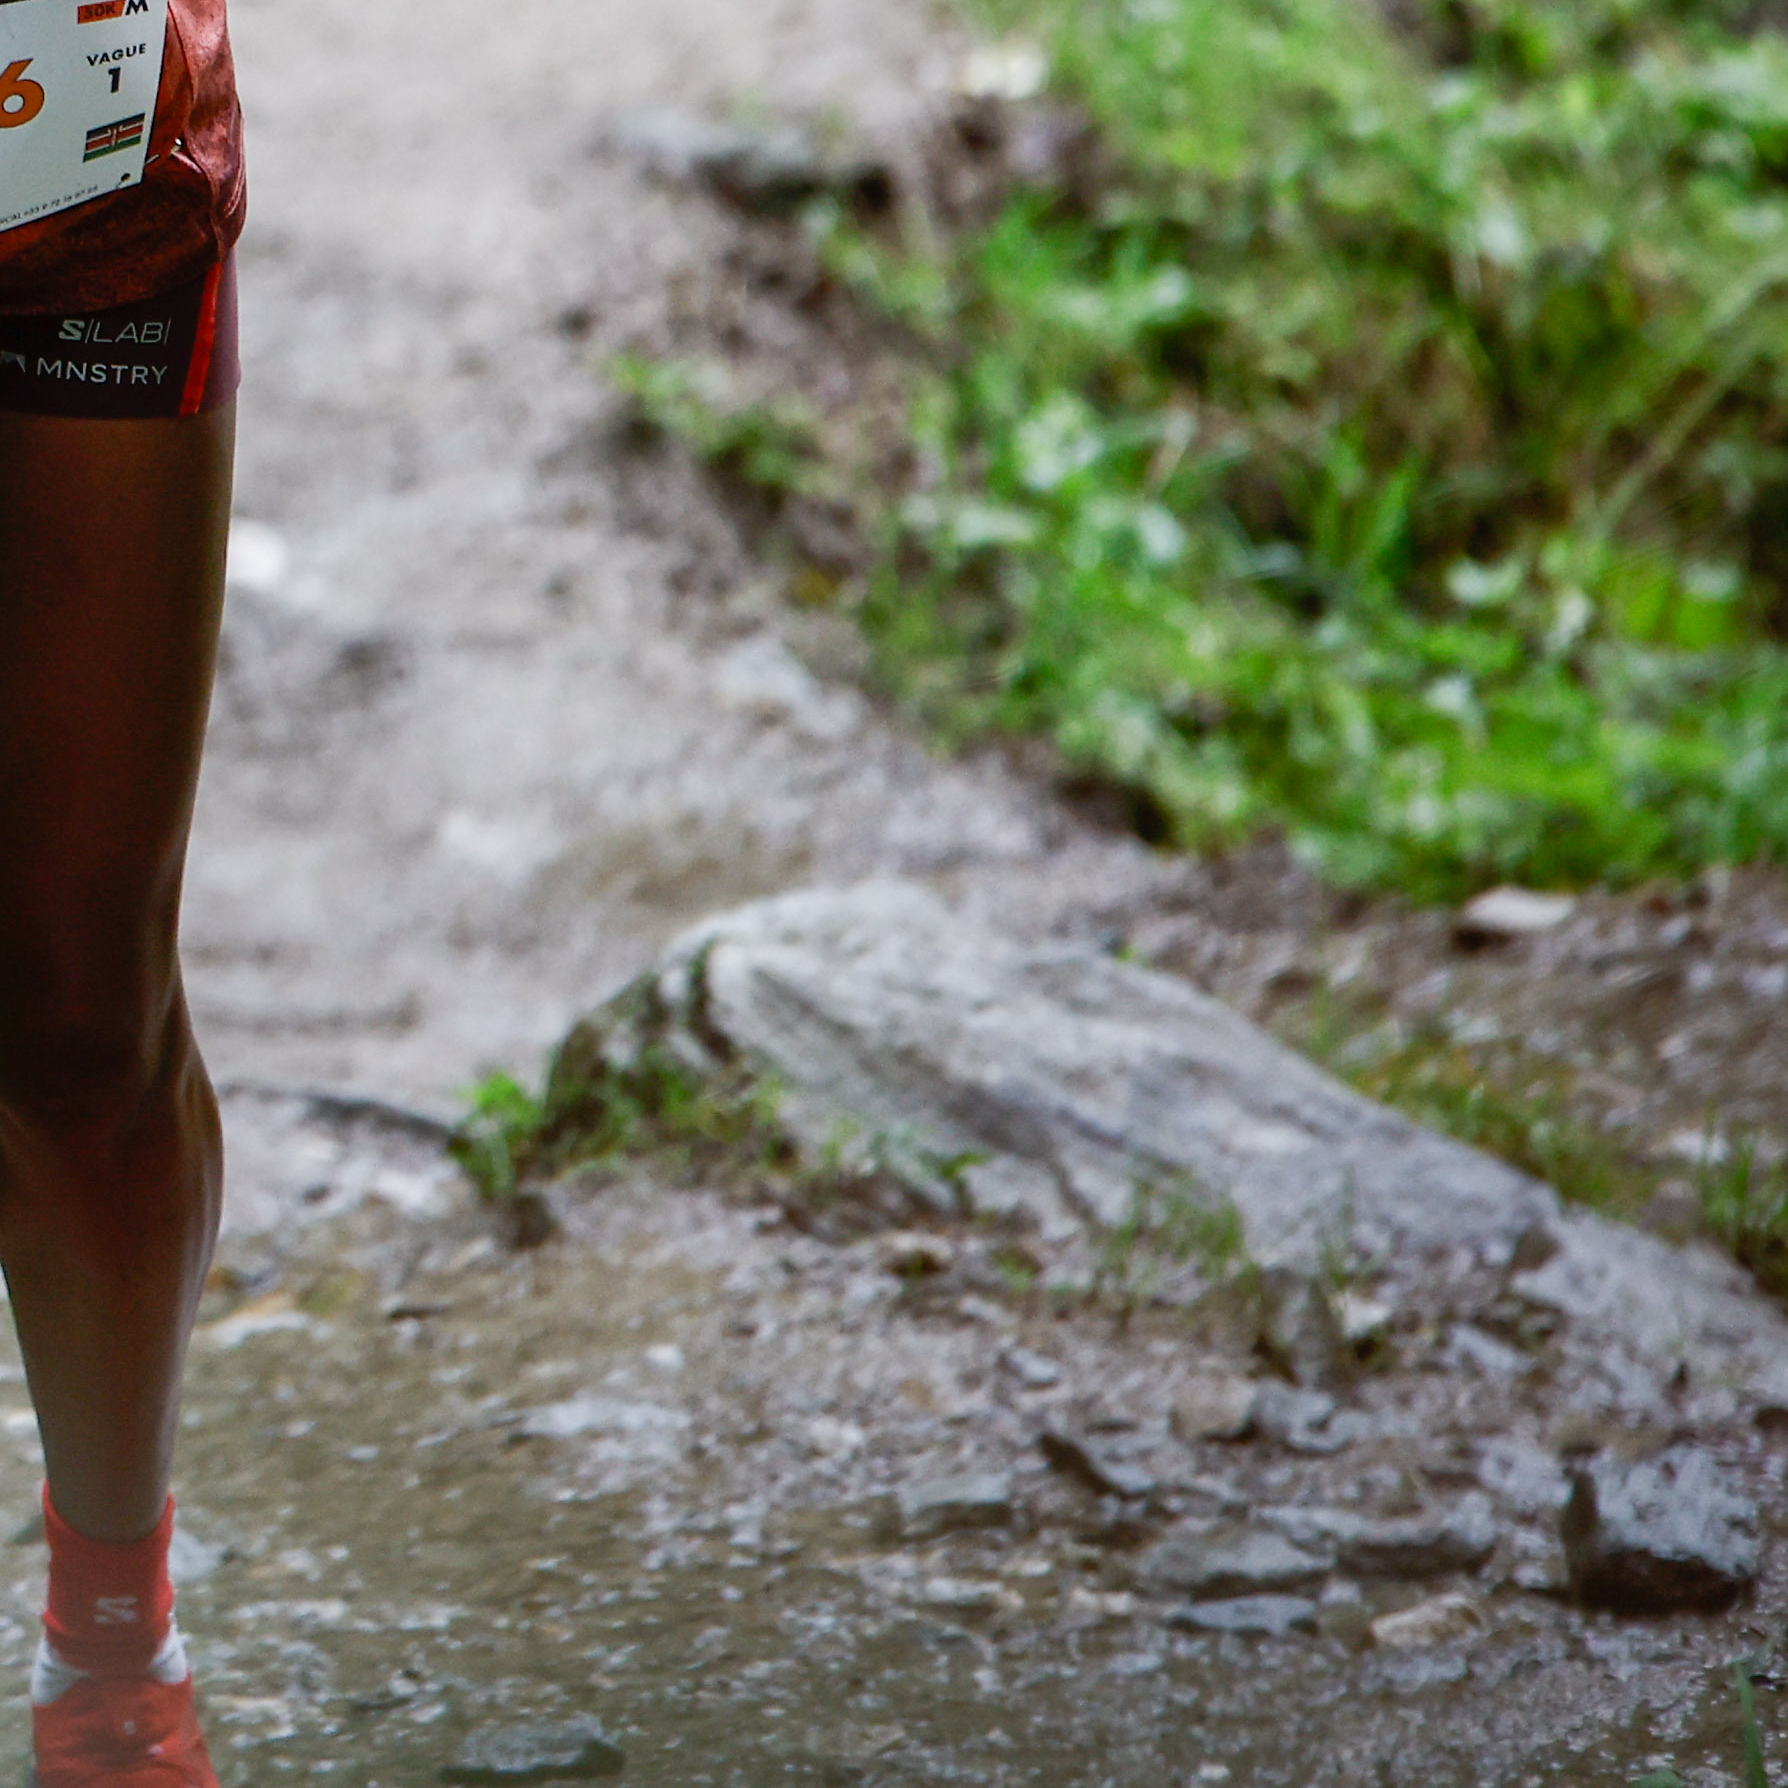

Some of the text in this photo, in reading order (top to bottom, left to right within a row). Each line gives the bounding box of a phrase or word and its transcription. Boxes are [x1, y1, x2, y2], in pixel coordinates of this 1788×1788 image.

[86, 43, 147, 67] VAGUE
[108, 66, 121, 94] 1
[36, 357, 168, 385] MNSTRY
